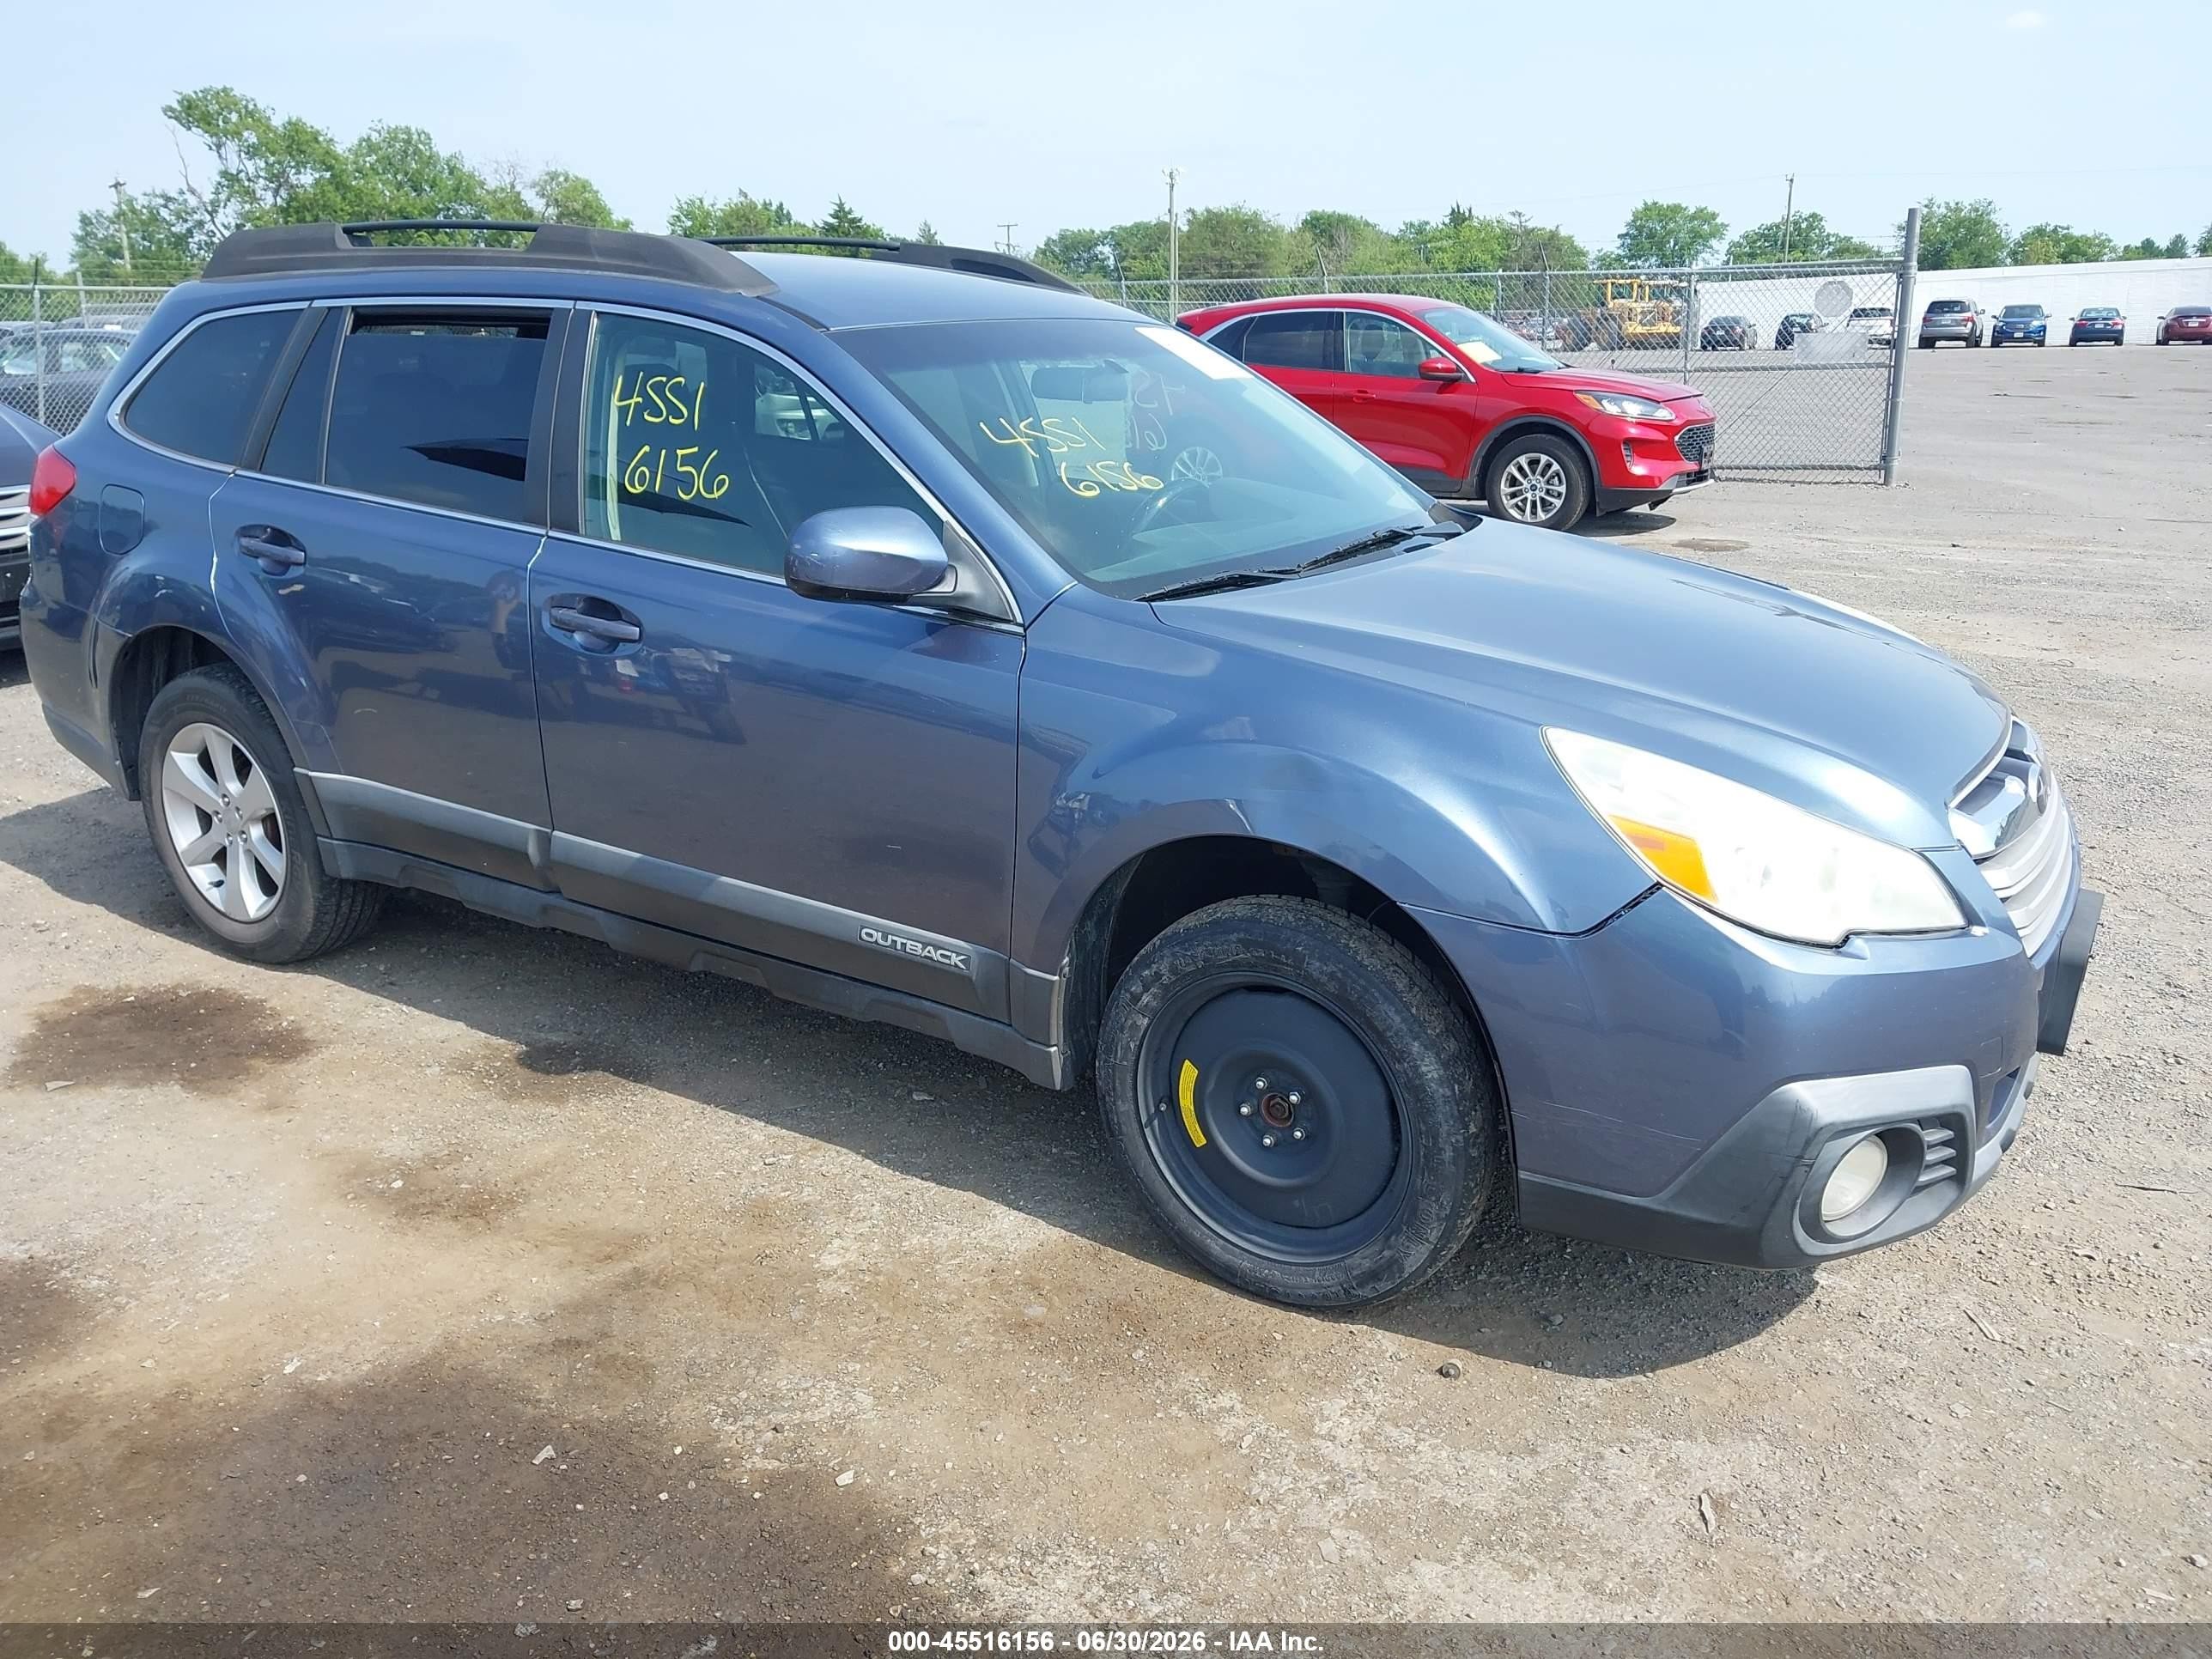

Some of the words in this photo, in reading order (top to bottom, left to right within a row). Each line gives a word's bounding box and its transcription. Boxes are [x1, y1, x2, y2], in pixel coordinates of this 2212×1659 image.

[613, 371, 705, 431] 4551
[624, 444, 729, 500] 6156
[1060, 460, 1164, 497] 6156
[860, 927, 969, 970] OUTBACK
